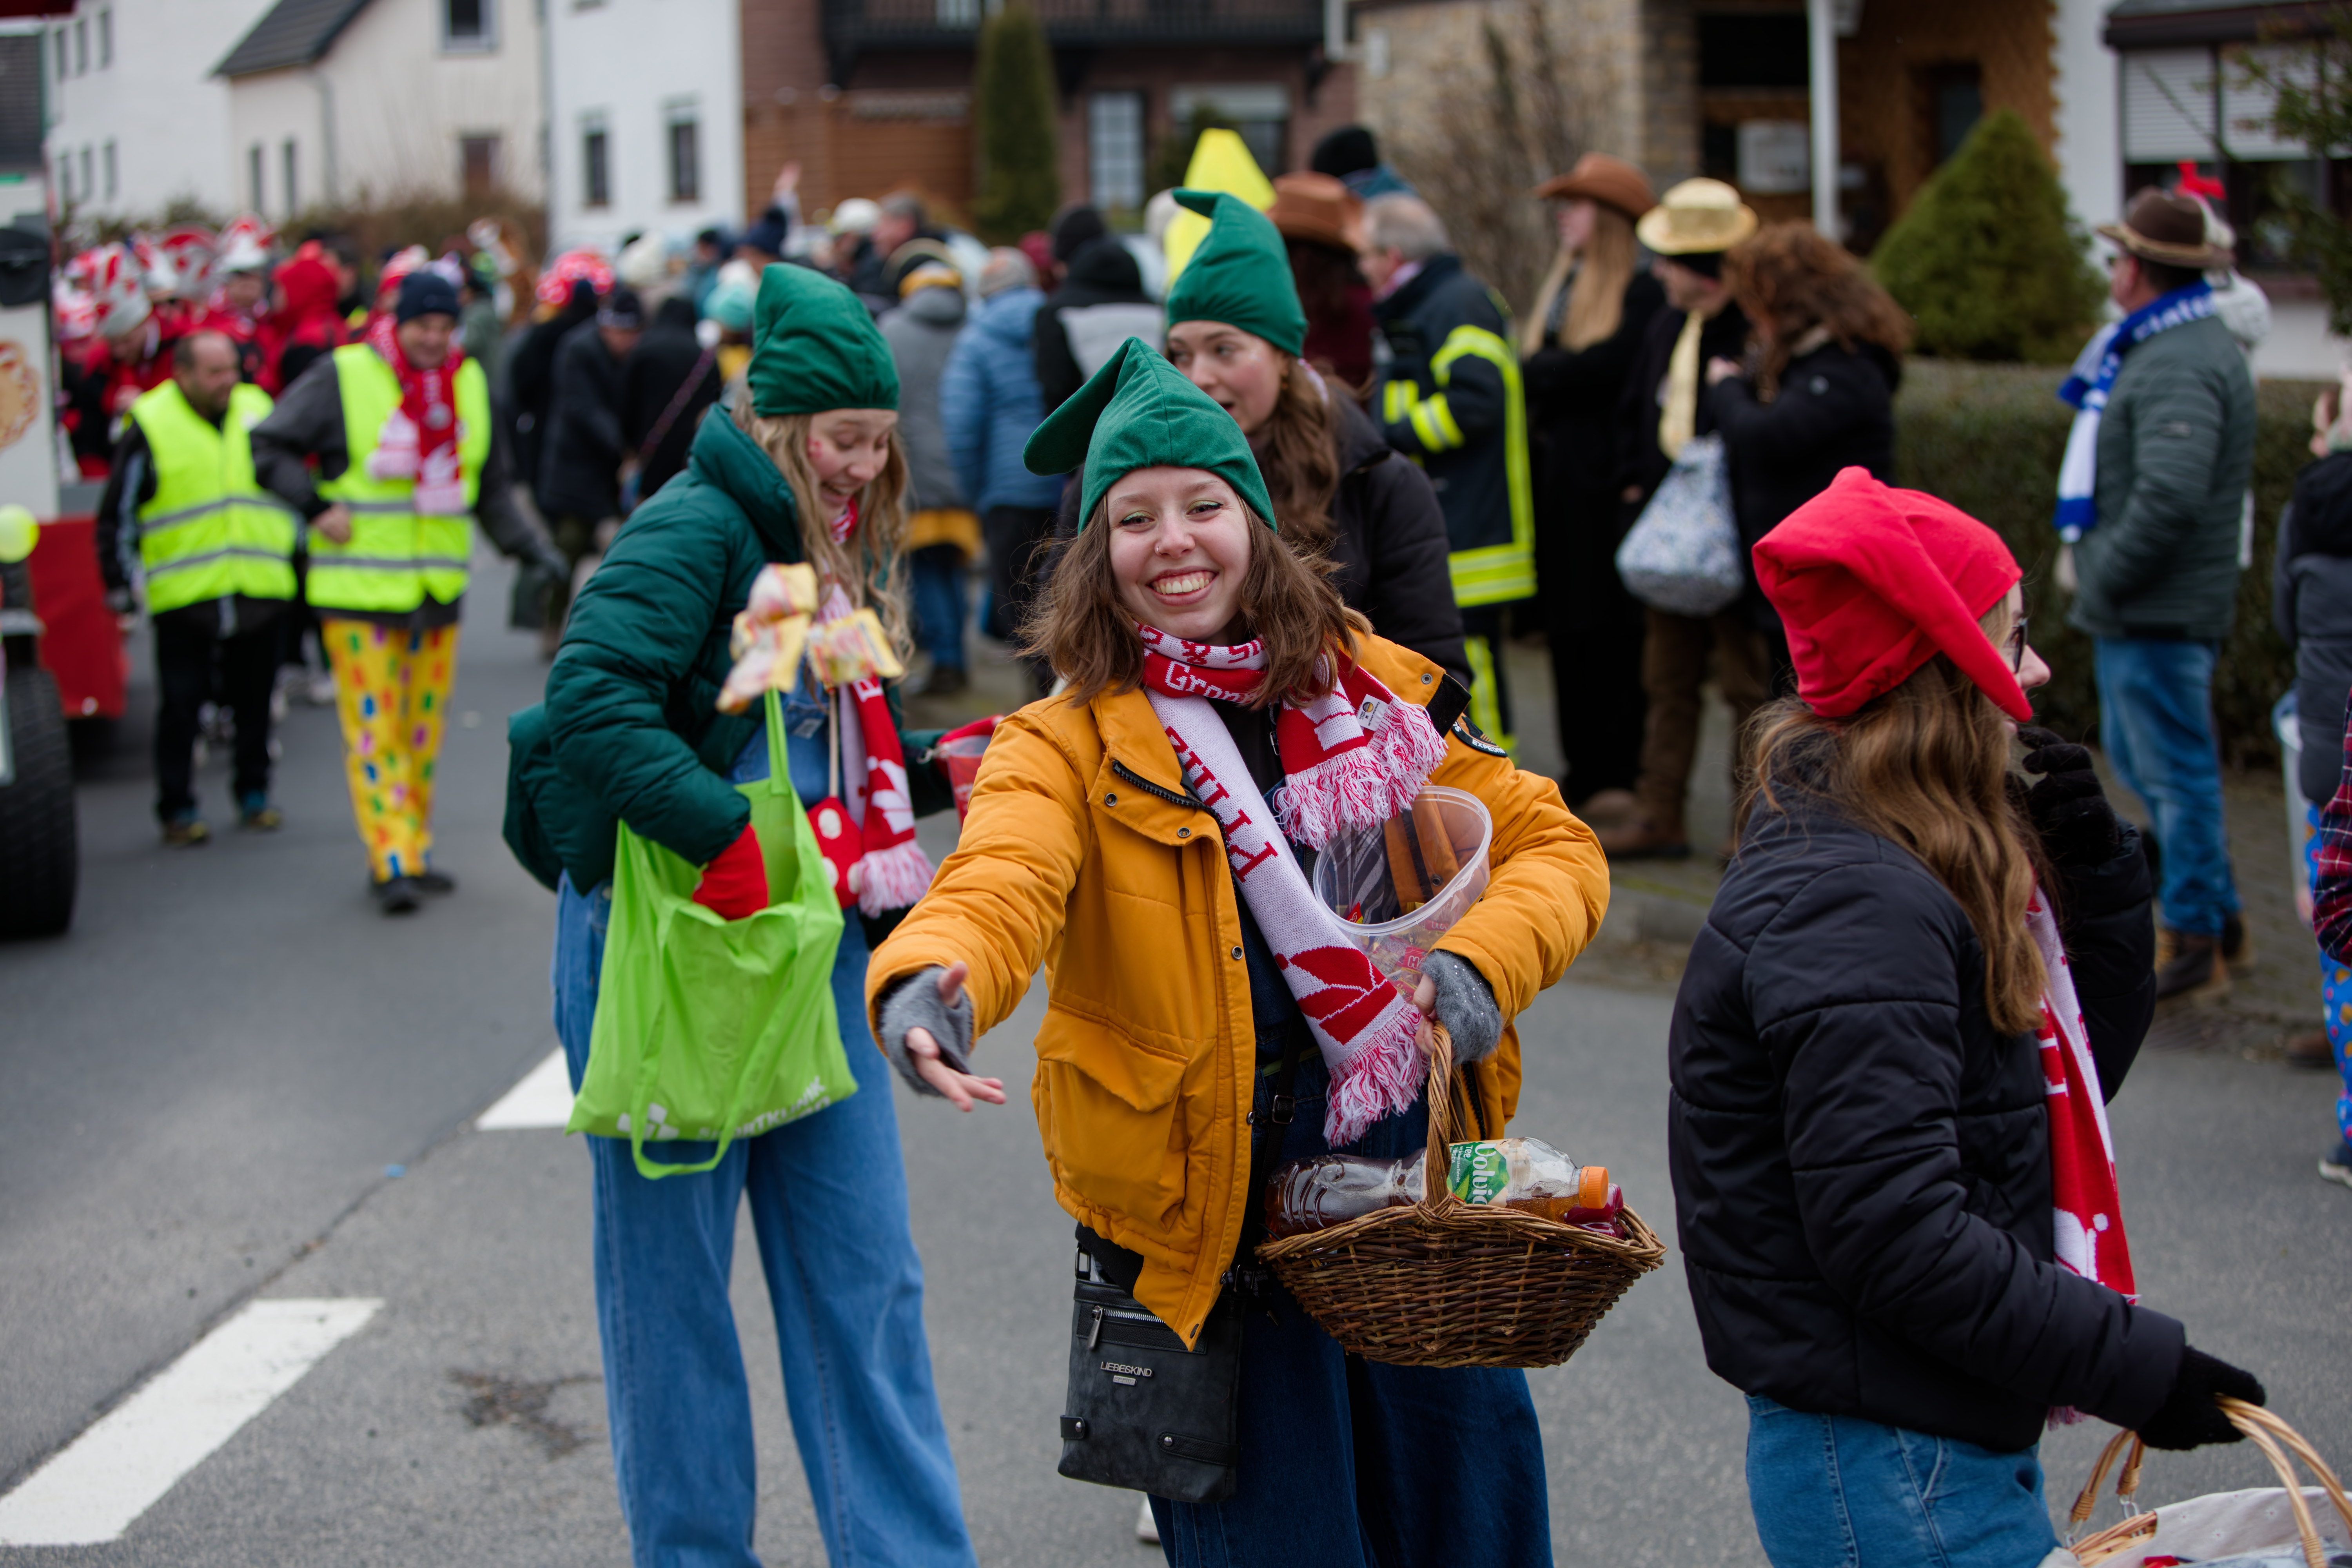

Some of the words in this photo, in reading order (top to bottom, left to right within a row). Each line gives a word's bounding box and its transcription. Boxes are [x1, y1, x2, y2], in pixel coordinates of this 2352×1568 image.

[1433, 901, 1451, 920] OUVRIR
[1408, 925, 1426, 937] OPEN
[1463, 1145, 1473, 1158] Tee
[1472, 1143, 1497, 1205] Volvic
[1100, 1361, 1152, 1377] LIEBESKIND
[1114, 1376, 1135, 1385] Berlin
